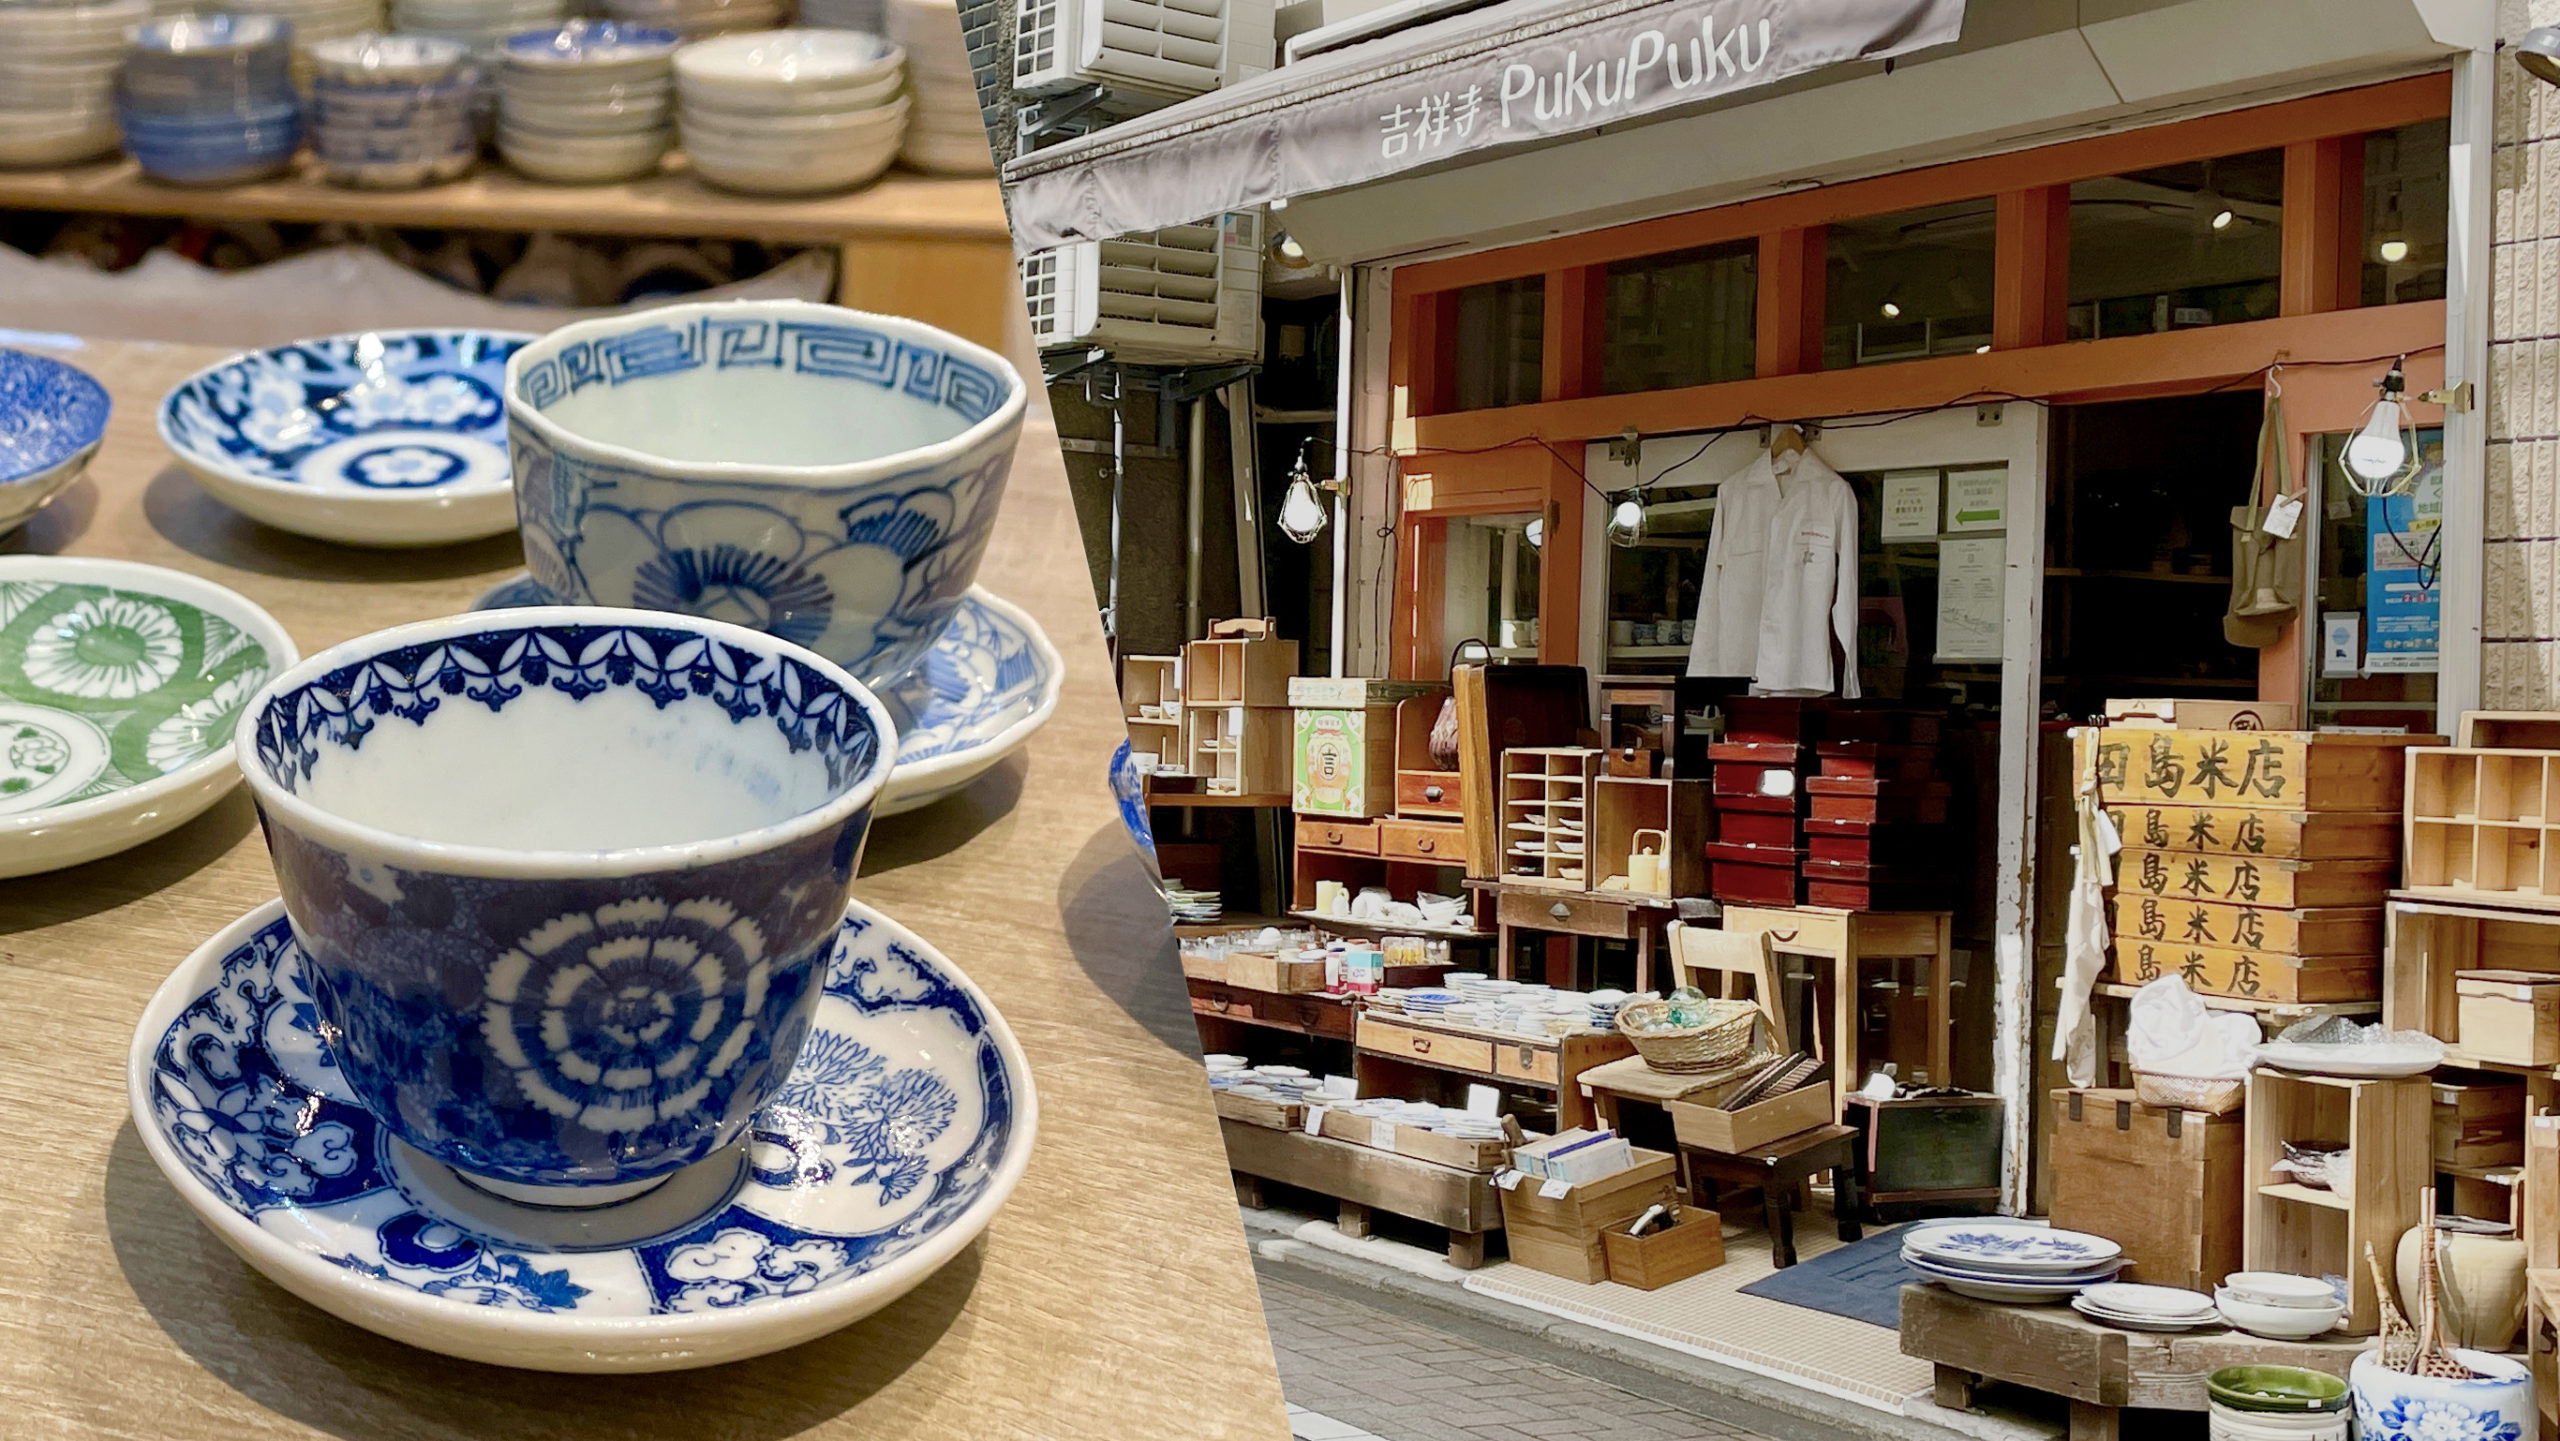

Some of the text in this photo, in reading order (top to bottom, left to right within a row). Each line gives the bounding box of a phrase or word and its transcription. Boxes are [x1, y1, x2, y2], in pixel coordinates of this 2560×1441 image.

[1500, 14, 1771, 129] PukuPuku
[1380, 83, 1483, 160] 吉祥寺
[2111, 852, 2262, 902] 島米店
[2109, 898, 2265, 950] 島米店
